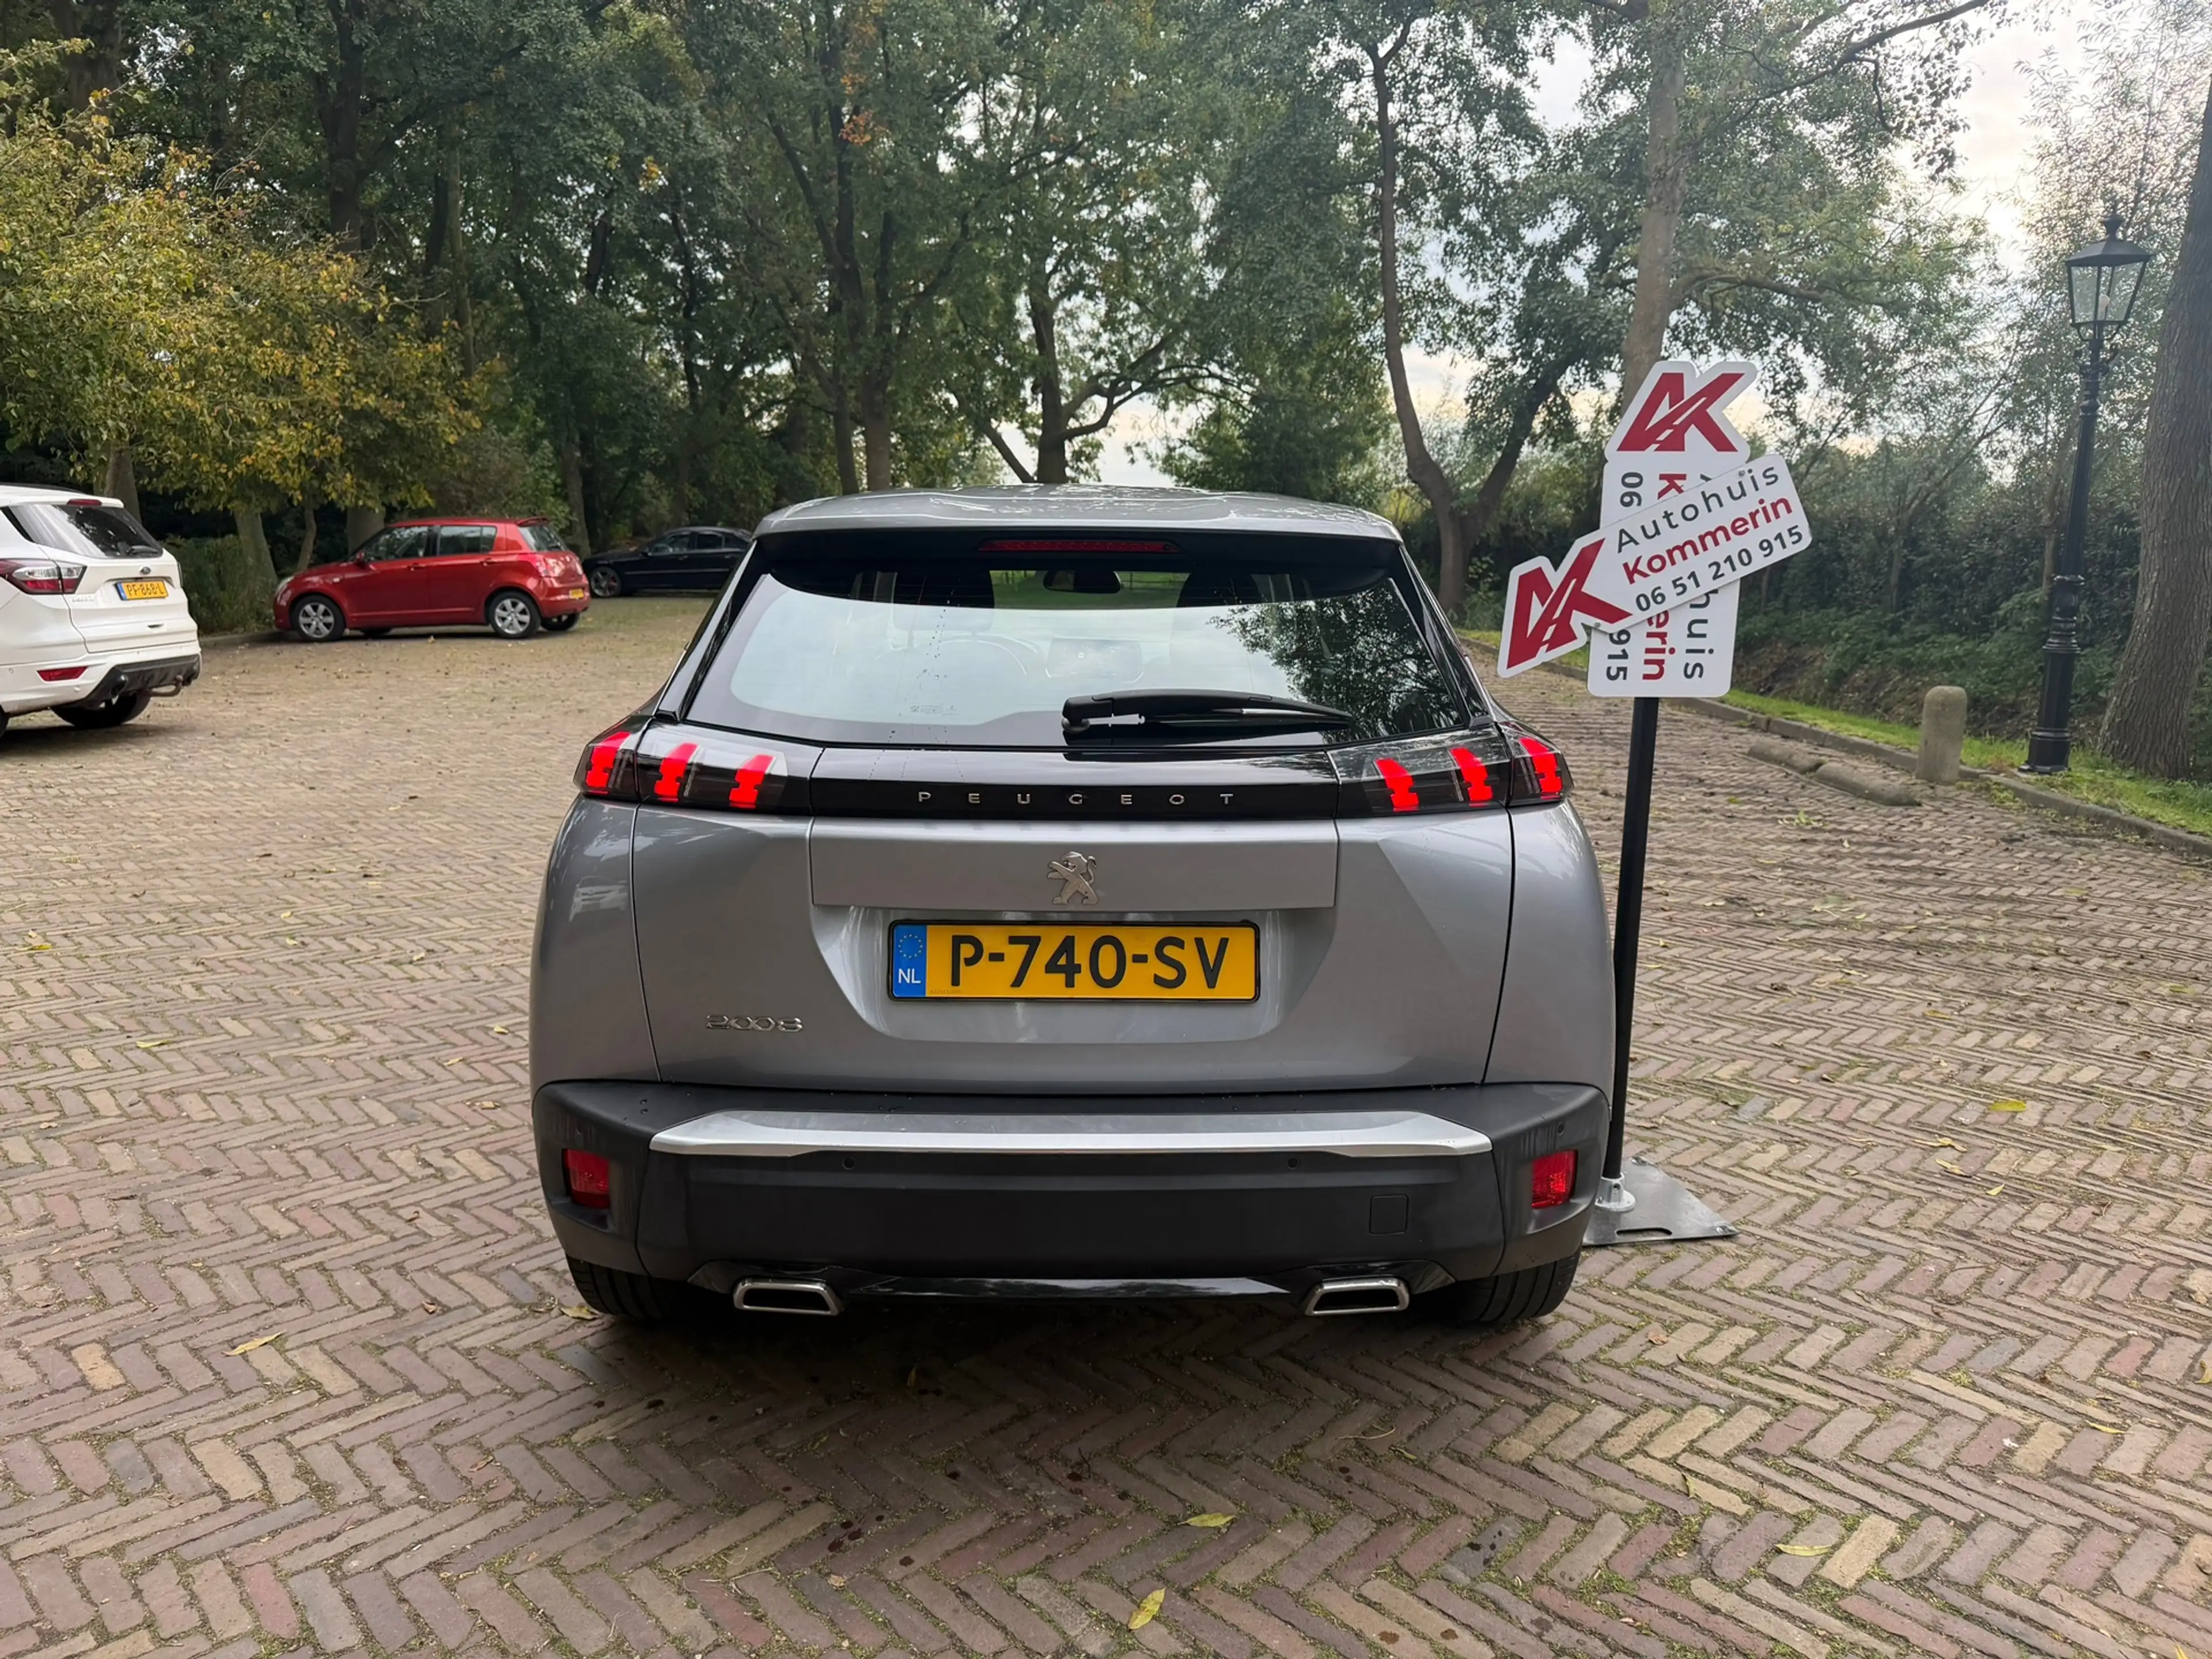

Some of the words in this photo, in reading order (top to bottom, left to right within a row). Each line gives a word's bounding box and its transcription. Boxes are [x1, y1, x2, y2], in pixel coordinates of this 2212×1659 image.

[1617, 467, 1779, 554] Autohuis
[1619, 472, 1644, 507] 06
[1622, 498, 1793, 585] Kommerin
[1635, 586, 1666, 612] 06
[1671, 571, 1701, 597] 51
[1707, 548, 1752, 581] 210
[1759, 525, 1803, 558] 915
[1605, 628, 1631, 681] 915
[918, 791, 1234, 806] PEUGEOT
[897, 968, 922, 984] NL
[950, 934, 1230, 990] P-740-SV
[705, 1014, 804, 1033] 2008
